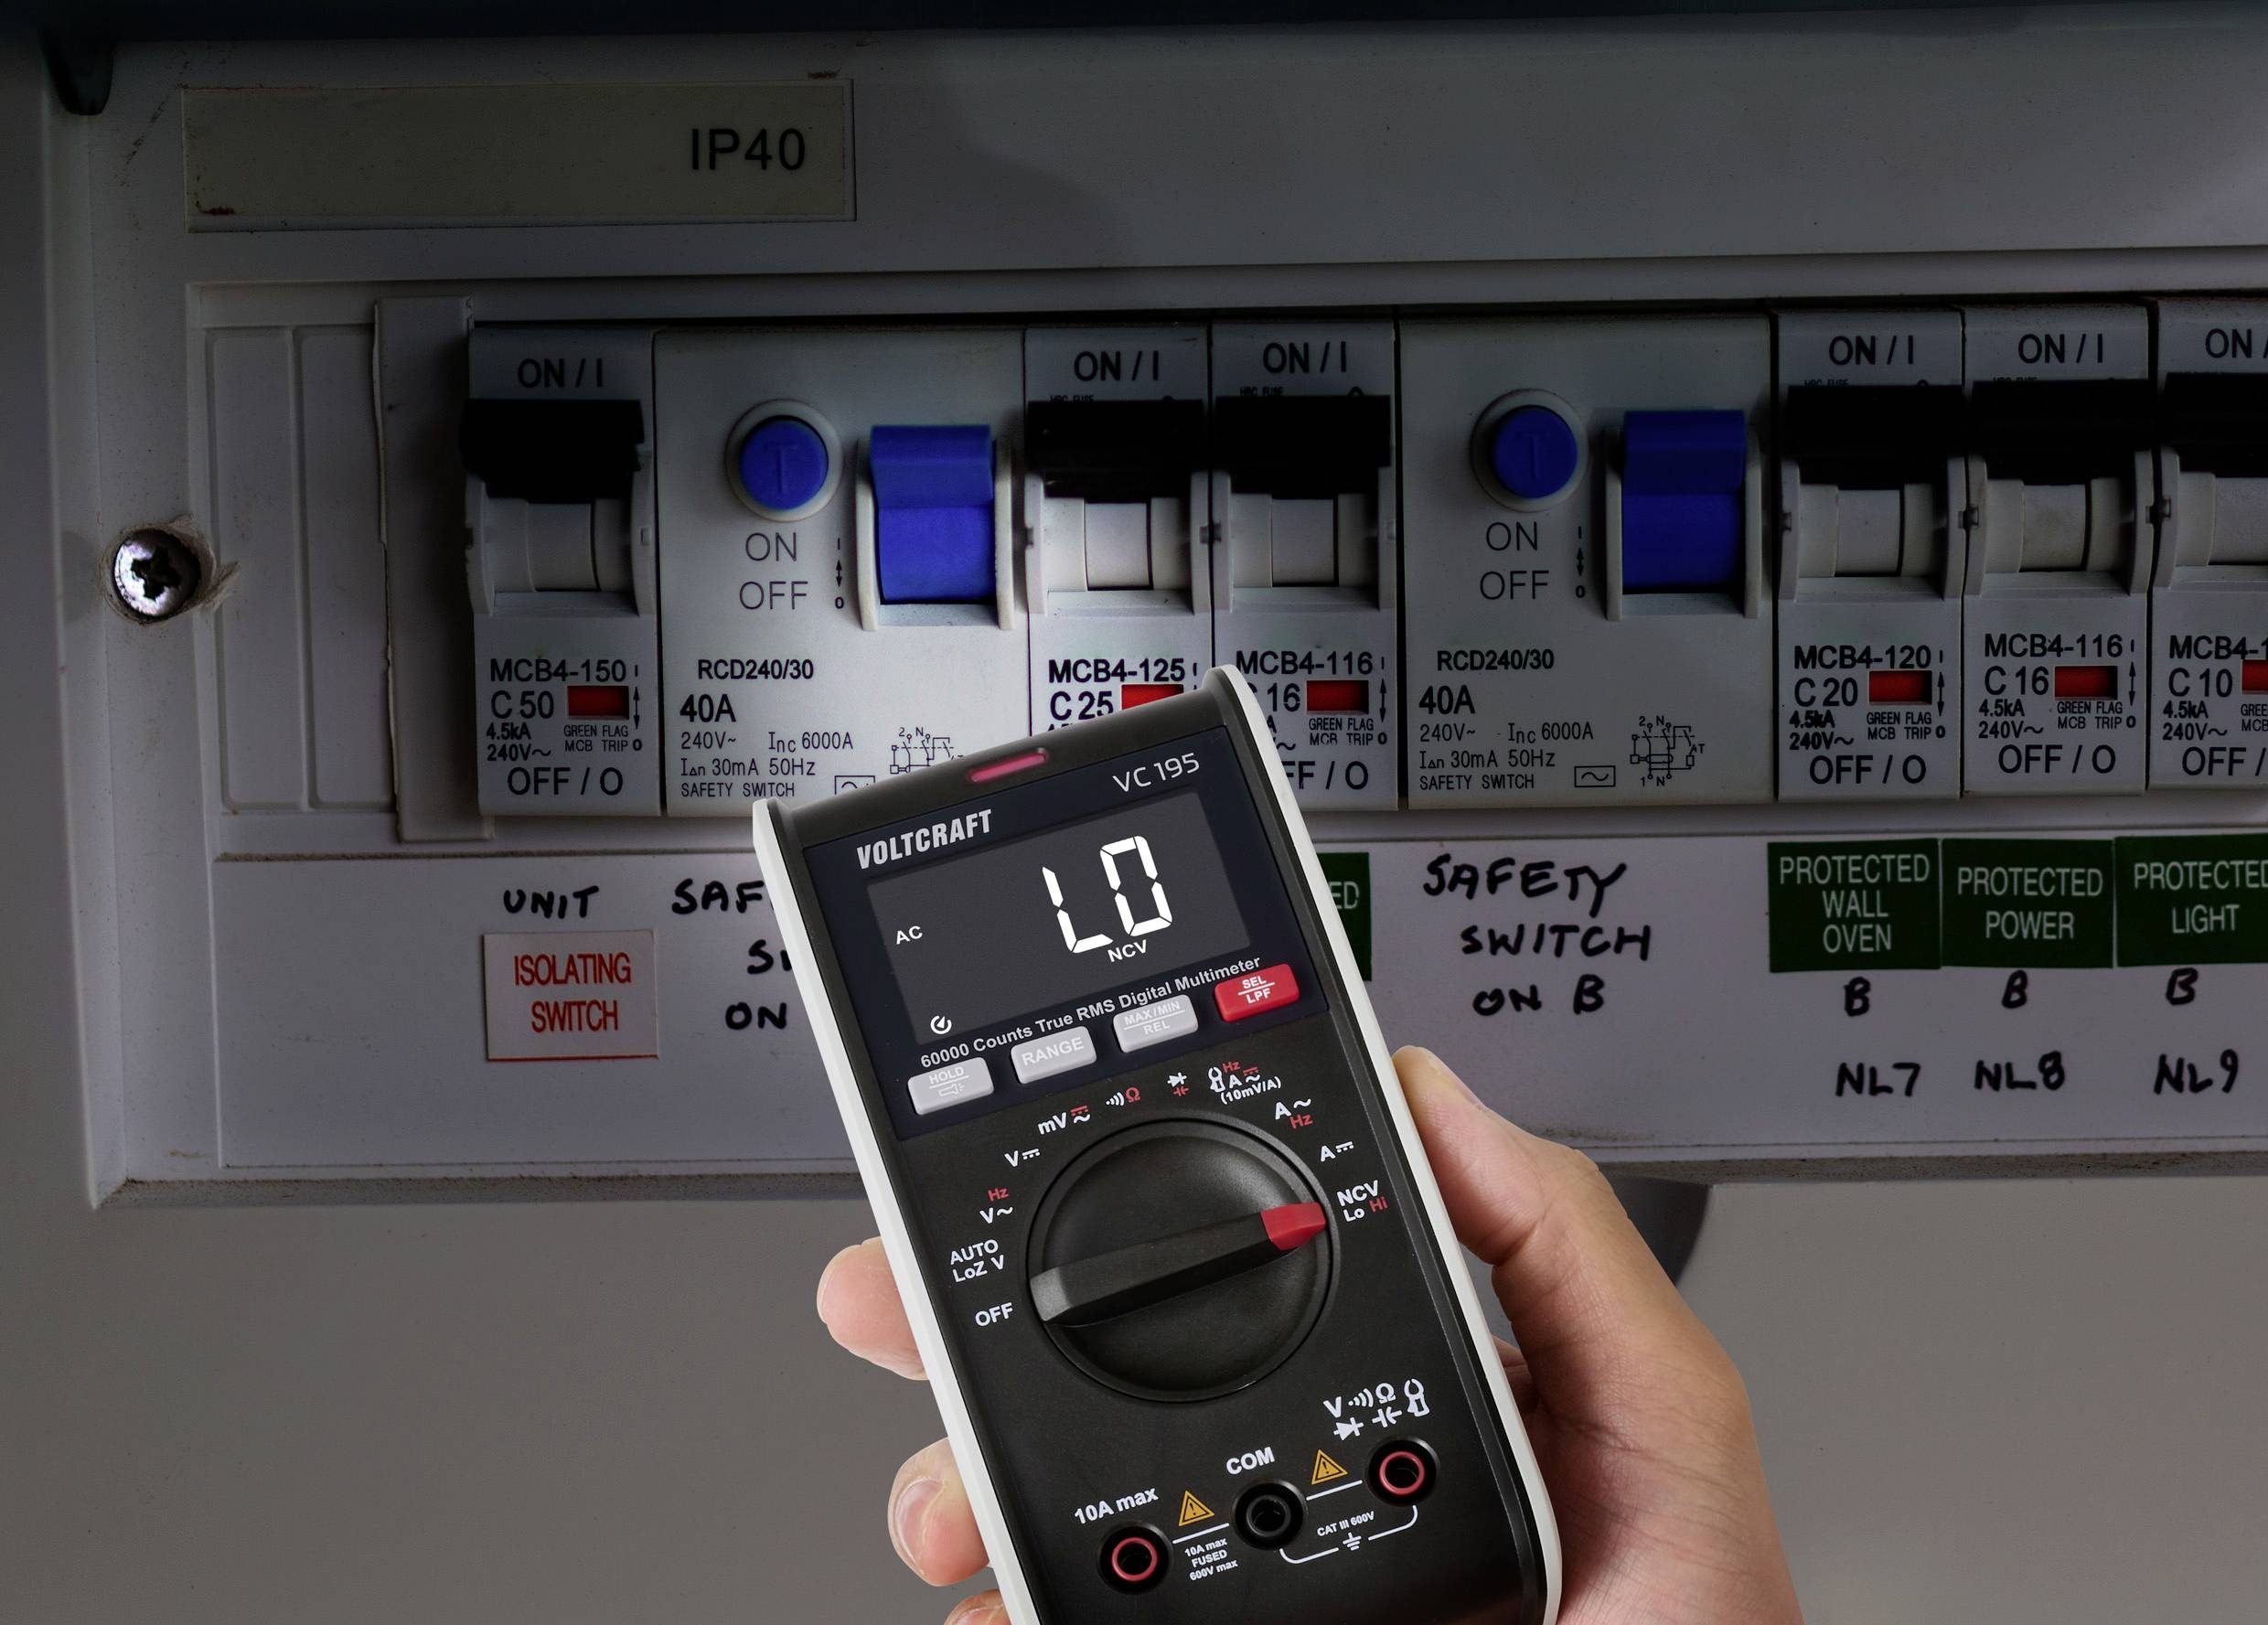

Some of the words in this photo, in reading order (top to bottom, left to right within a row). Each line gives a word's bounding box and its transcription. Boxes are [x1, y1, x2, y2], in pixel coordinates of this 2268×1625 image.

[691, 127, 806, 170] IP40
[1829, 336, 1876, 366] ON
[2018, 334, 2065, 364] ON
[2205, 328, 2252, 358] ON
[1074, 351, 1120, 382] ON
[1263, 342, 1310, 374] ON
[518, 358, 565, 387] ON
[745, 532, 796, 561] ON
[1487, 522, 1537, 551] ON
[740, 582, 808, 609] OFF
[1481, 571, 1549, 599] OFF
[1794, 645, 1931, 669] MCB4-120
[1984, 633, 2123, 657] MCB4-116
[2169, 635, 2268, 659] MCB4-1
[490, 658, 626, 682] MCB4-150
[698, 659, 813, 679] RCD240/30
[1049, 658, 1185, 683] MCB4-125
[1236, 650, 1373, 675] MCB4-116
[1438, 649, 1554, 671] RCD240/30
[680, 693, 736, 722] 40A
[1419, 685, 1475, 714] 40A
[1979, 699, 2025, 717] 4.5kA
[2058, 702, 2091, 714] GREEN
[2096, 702, 2123, 714] FLAG
[2163, 700, 2209, 719] 4.5kA
[487, 722, 530, 740] 4.5kA
[564, 725, 596, 737] GREEN
[602, 725, 628, 737] FLAG
[1309, 718, 1342, 731] GREEN
[1348, 718, 1374, 731] FLAG
[1790, 710, 1835, 728] 4.5kA
[1867, 712, 1899, 724] GREEN
[1906, 712, 1931, 724] FLAG
[2058, 717, 2085, 729] MCB
[2095, 717, 2122, 729] TRIP
[802, 732, 853, 750] 6000A
[1310, 733, 1337, 745] MCB
[1347, 733, 1373, 745] TRIP
[1542, 722, 1593, 741] 6000A
[1867, 727, 1895, 740] MCB
[1904, 727, 1931, 740] TRIP
[565, 740, 593, 751] MCB
[602, 740, 627, 751] TRIP
[1451, 750, 1497, 768] 30mA
[1508, 749, 1555, 768] 50Hz
[711, 758, 758, 775] 30mA
[769, 758, 816, 775] 50Hz
[1810, 754, 1873, 785] OFF
[1998, 744, 2062, 774] OFF
[2182, 746, 2246, 775] OFF
[508, 767, 570, 795] OFF
[1112, 766, 1151, 793] VC
[1155, 753, 1200, 783] 195
[1419, 775, 1471, 791] SAFETY
[1482, 775, 1535, 789] SWITCH
[681, 783, 732, 797] SAFETY
[743, 783, 795, 797] SWITCH
[857, 809, 992, 870] VOLTCRAFT
[1780, 854, 1930, 885] PROTECTED
[1957, 867, 2102, 897] PROTECTED
[671, 878, 766, 914] SAF
[1423, 853, 1626, 917] SAFETY
[503, 885, 599, 919] UNIT
[1822, 891, 1888, 918] WALL
[1985, 911, 2074, 939] POWER
[2172, 904, 2240, 935] LIGHT
[895, 925, 923, 946] AC
[1460, 923, 1651, 961] SWITCH
[1823, 924, 1891, 953] OVEN
[1107, 940, 1148, 963] NCV
[514, 952, 631, 987] ISOLATING
[1242, 976, 1267, 989] SEL
[1246, 989, 1271, 1004] LPF
[1472, 985, 1542, 1016] ON
[1573, 974, 1605, 1015] B
[1844, 976, 1870, 1017] B
[2001, 969, 2028, 1008] B
[531, 1000, 618, 1032] SWITCH
[725, 1002, 786, 1030] ON
[921, 1043, 969, 1068] 60000
[973, 1025, 1032, 1053] Counts
[1035, 1013, 1074, 1034] True
[1076, 999, 1114, 1021] RMS
[1119, 982, 1171, 1011] Digital
[1175, 957, 1260, 991] Multimeter
[1123, 1000, 1181, 1026] MAX/MIN
[1143, 1020, 1171, 1034] REL
[1022, 1037, 1085, 1067] RANGE
[928, 1066, 965, 1084] HOLD
[1223, 1062, 1241, 1074] Hz
[1835, 1062, 1920, 1097] NL7
[1974, 1050, 2066, 1090] NL8
[2154, 1049, 2239, 1095] NL9
[1220, 1075, 1281, 1105] (10mV/A)
[1289, 1114, 1313, 1128] Hz
[988, 1188, 1009, 1202] Hz
[1336, 1180, 1378, 1206] NCV
[1343, 1208, 1364, 1222] Lo
[1369, 1197, 1388, 1213] Hi
[950, 1239, 999, 1265] AUTO
[953, 1260, 987, 1283] LoZ
[991, 1255, 1004, 1270] V
[975, 1302, 1013, 1327] OFF
[1225, 1447, 1275, 1476] COM
[1074, 1500, 1114, 1524] 10A
[1116, 1487, 1159, 1512] max
[1317, 1524, 1337, 1537] CAT
[1350, 1511, 1375, 1526] 600V
[1184, 1543, 1204, 1556] 10A
[1205, 1537, 1227, 1552] max
[1192, 1549, 1227, 1568] FUSED
[1189, 1566, 1214, 1582] 600V
[1215, 1559, 1238, 1576] max
